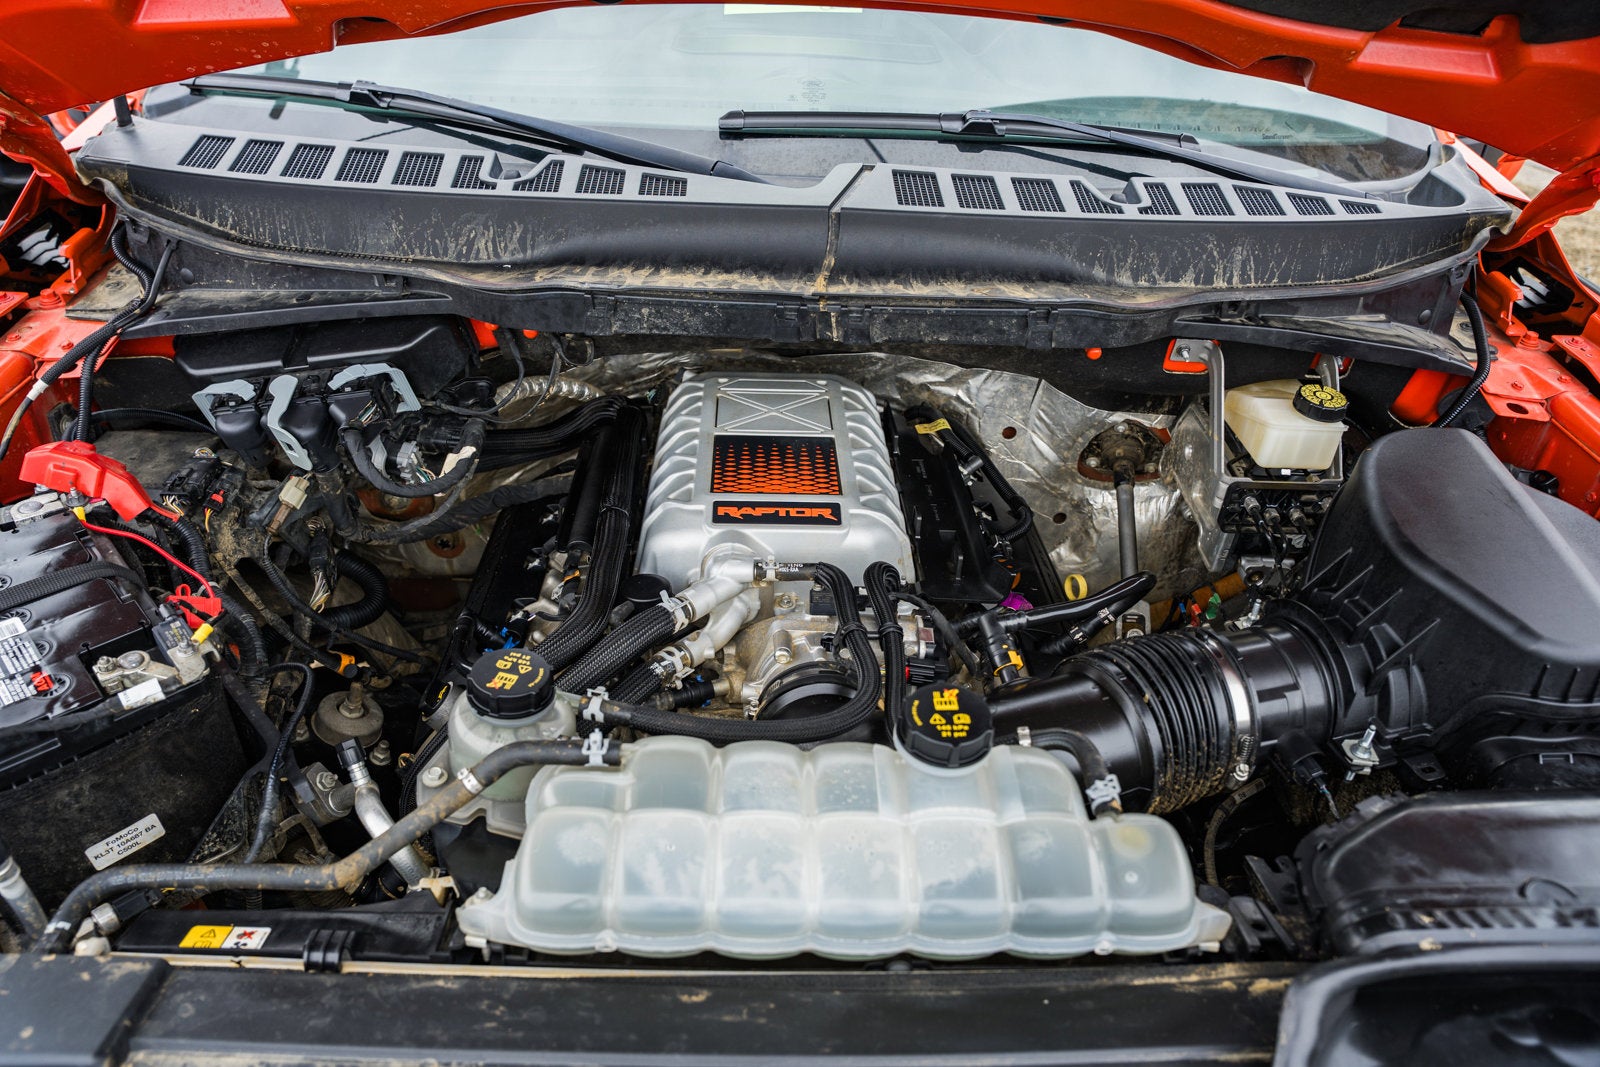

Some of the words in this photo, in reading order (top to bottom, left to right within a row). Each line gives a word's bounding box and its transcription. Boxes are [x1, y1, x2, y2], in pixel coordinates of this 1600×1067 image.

[717, 506, 838, 521] RAPTOR
[105, 827, 139, 847] FoMoCo
[93, 847, 115, 860] KL3T
[117, 841, 142, 855] C500L
